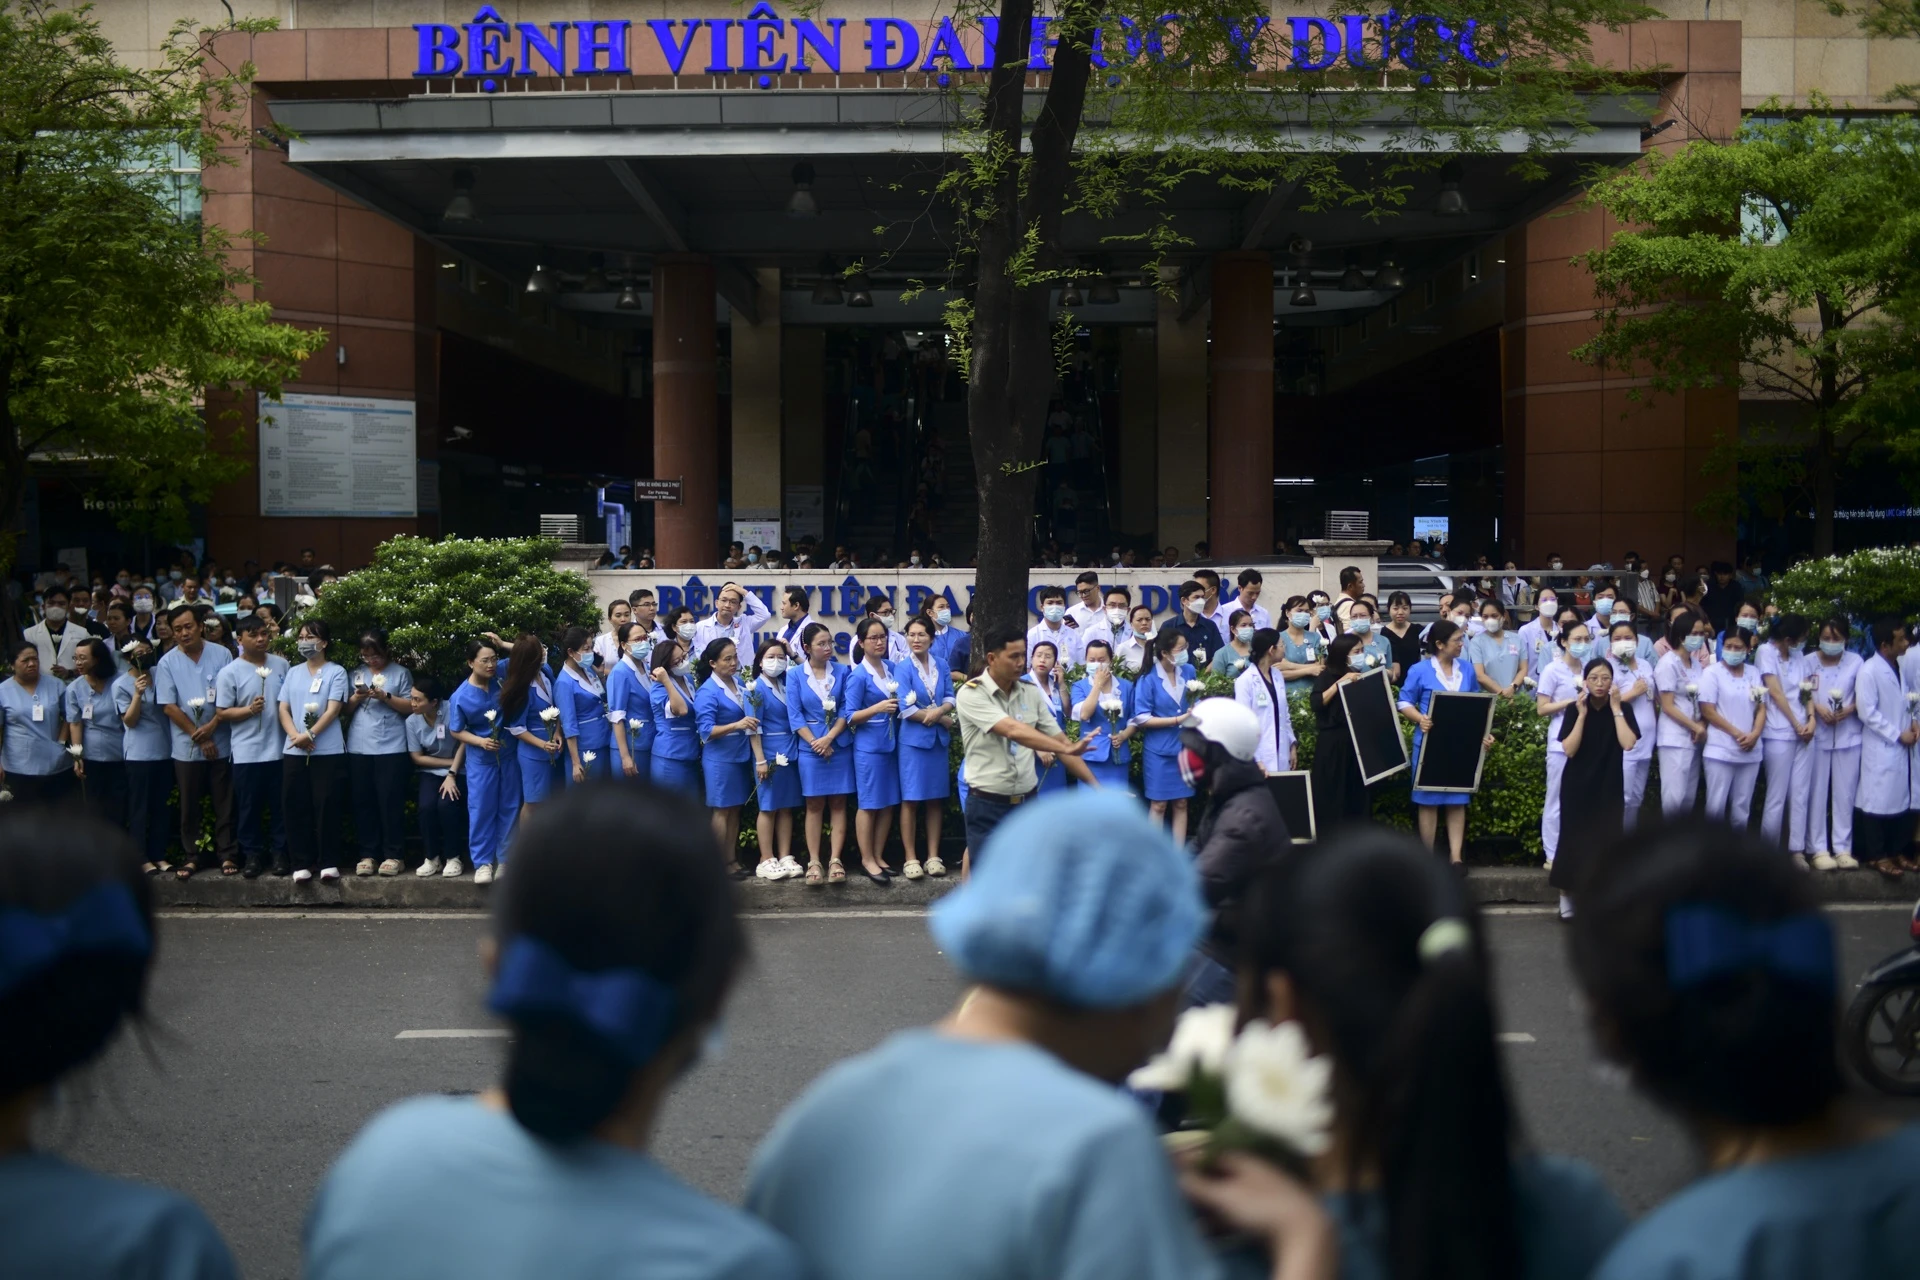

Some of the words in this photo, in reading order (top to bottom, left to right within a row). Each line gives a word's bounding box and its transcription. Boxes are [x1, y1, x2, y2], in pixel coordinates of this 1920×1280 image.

[411, 5, 632, 94] BỆNH
[646, 2, 846, 90] VIỆN
[864, 15, 1000, 88] ĐẠI
